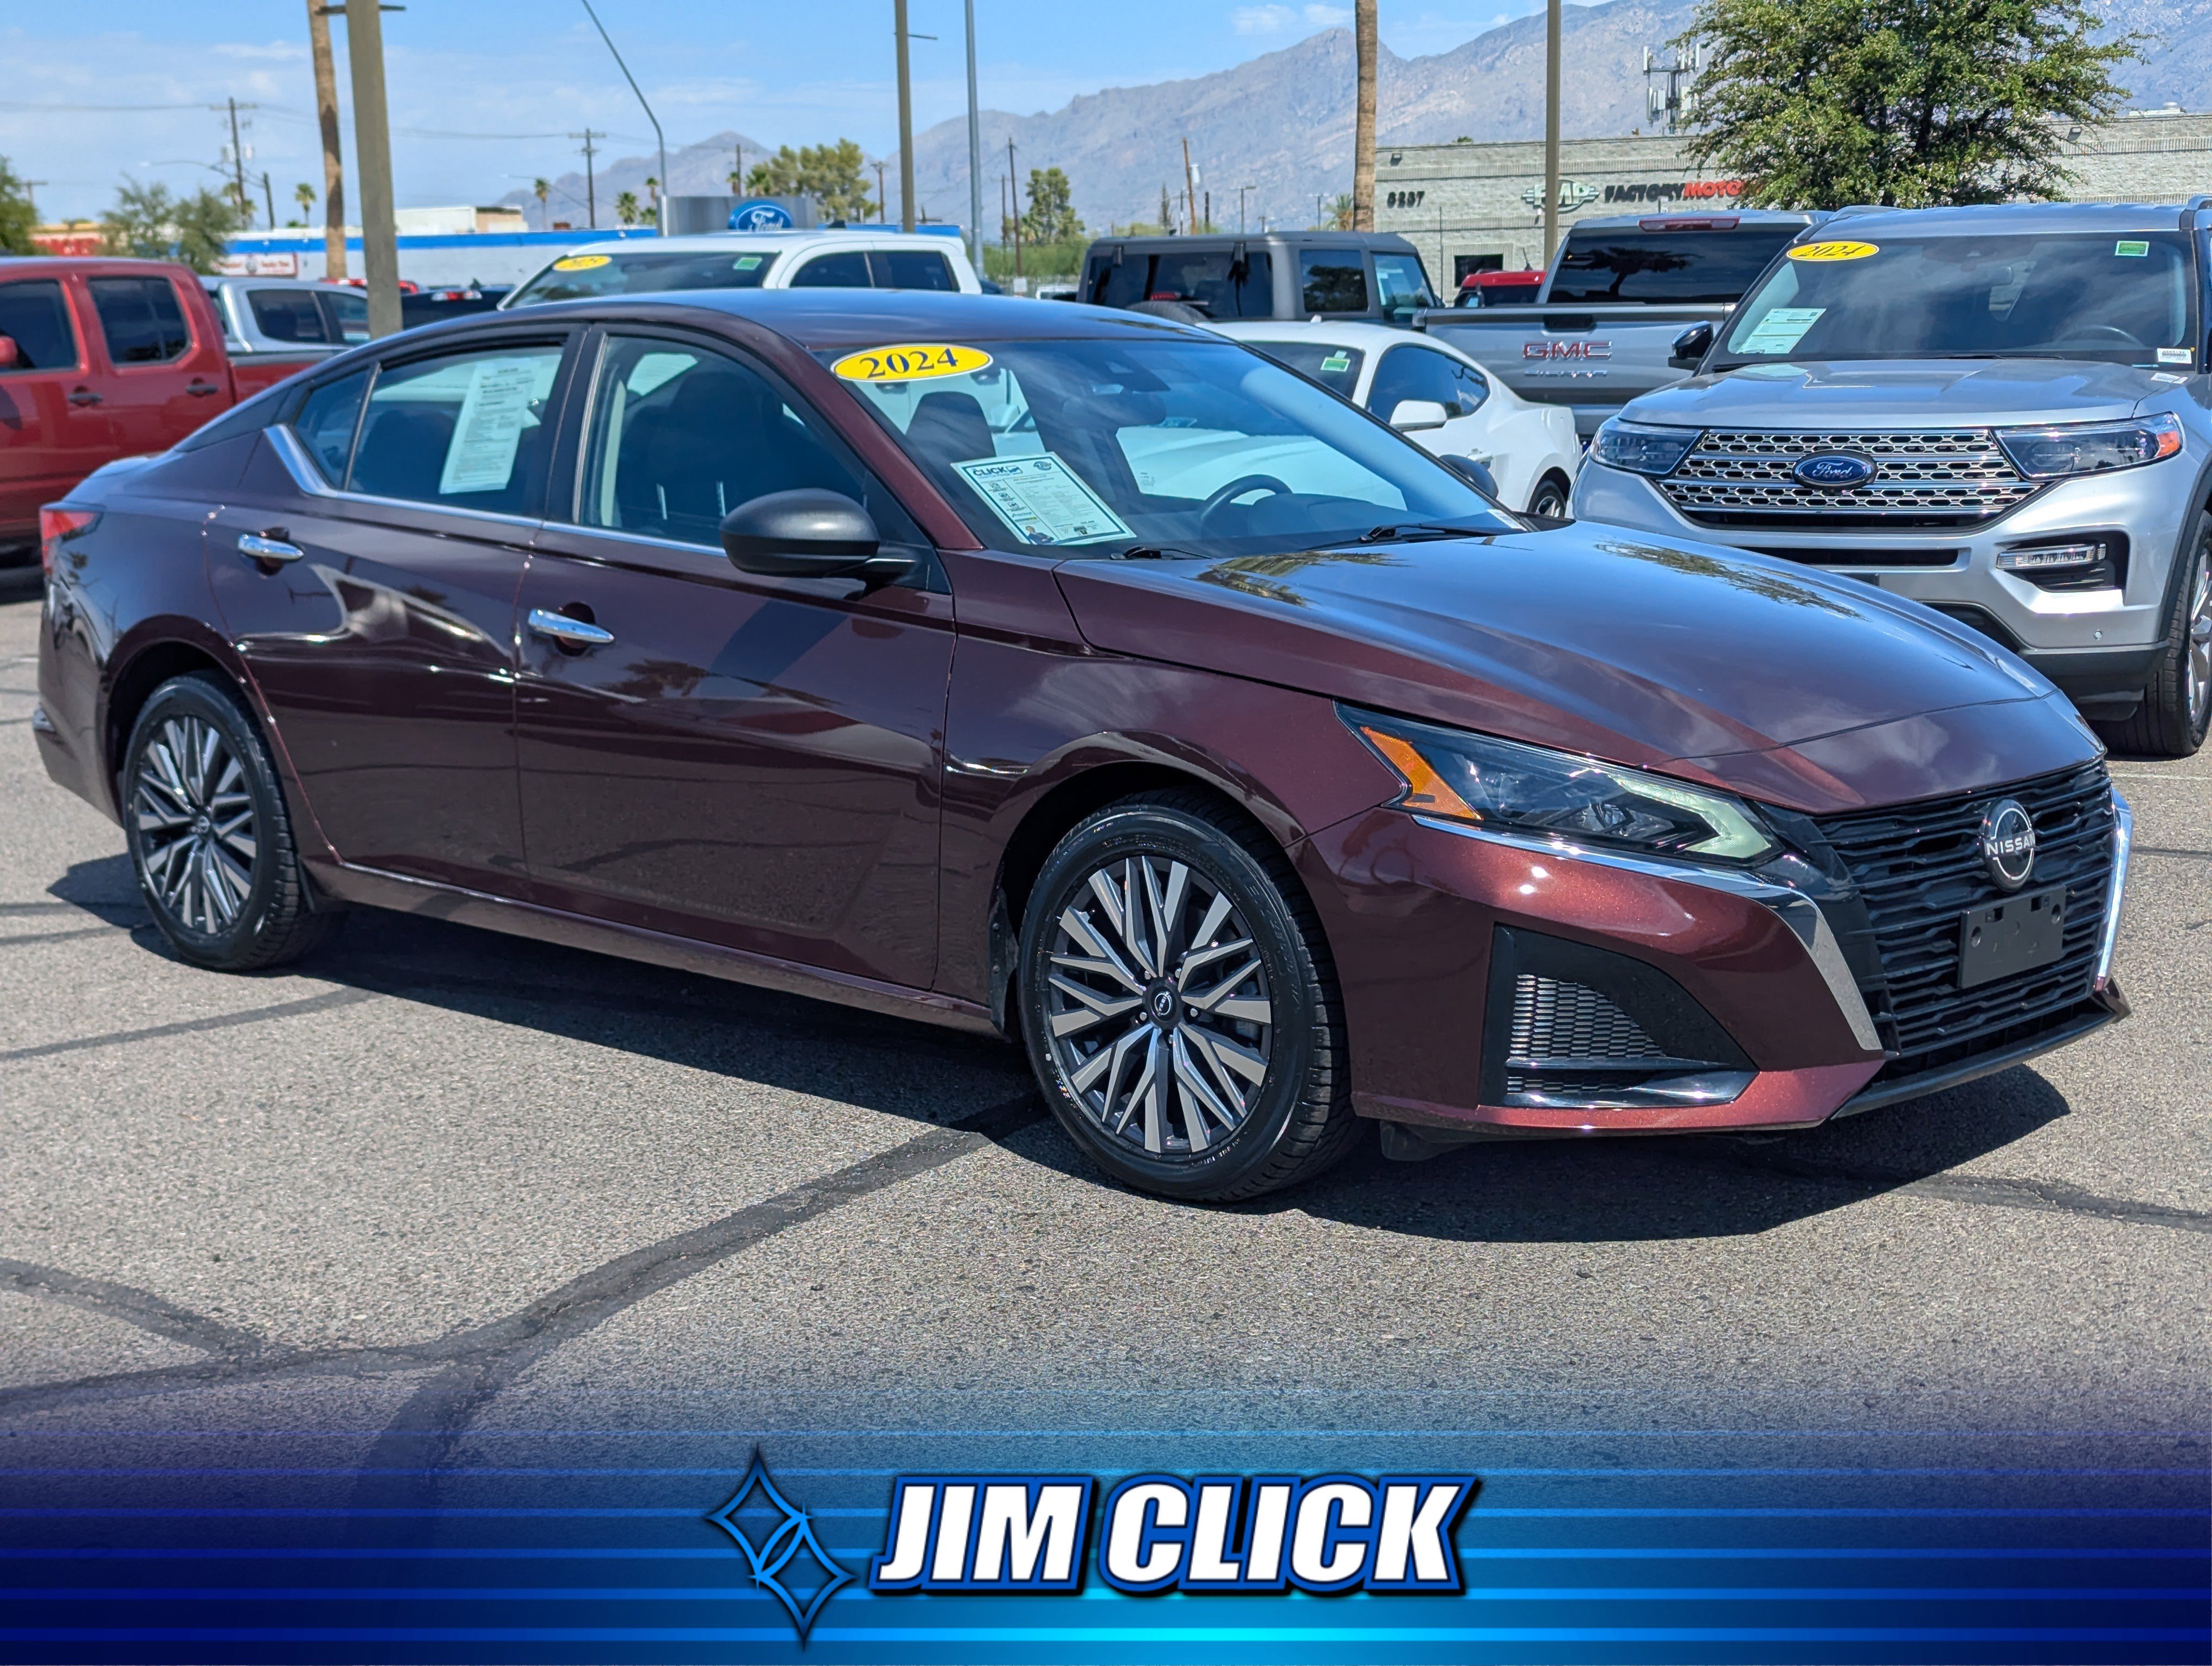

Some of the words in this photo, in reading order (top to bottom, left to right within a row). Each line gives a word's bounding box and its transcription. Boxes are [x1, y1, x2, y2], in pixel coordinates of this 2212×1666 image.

[1605, 183, 1685, 203] FACTORY
[1683, 180, 1746, 200] MOTO
[1796, 245, 1866, 257] 2024
[1523, 341, 1611, 361] GMC
[859, 348, 959, 379] 2024
[973, 466, 1007, 476] CLICK
[1812, 462, 1853, 478] Ford
[1986, 832, 2036, 856] NISSAN
